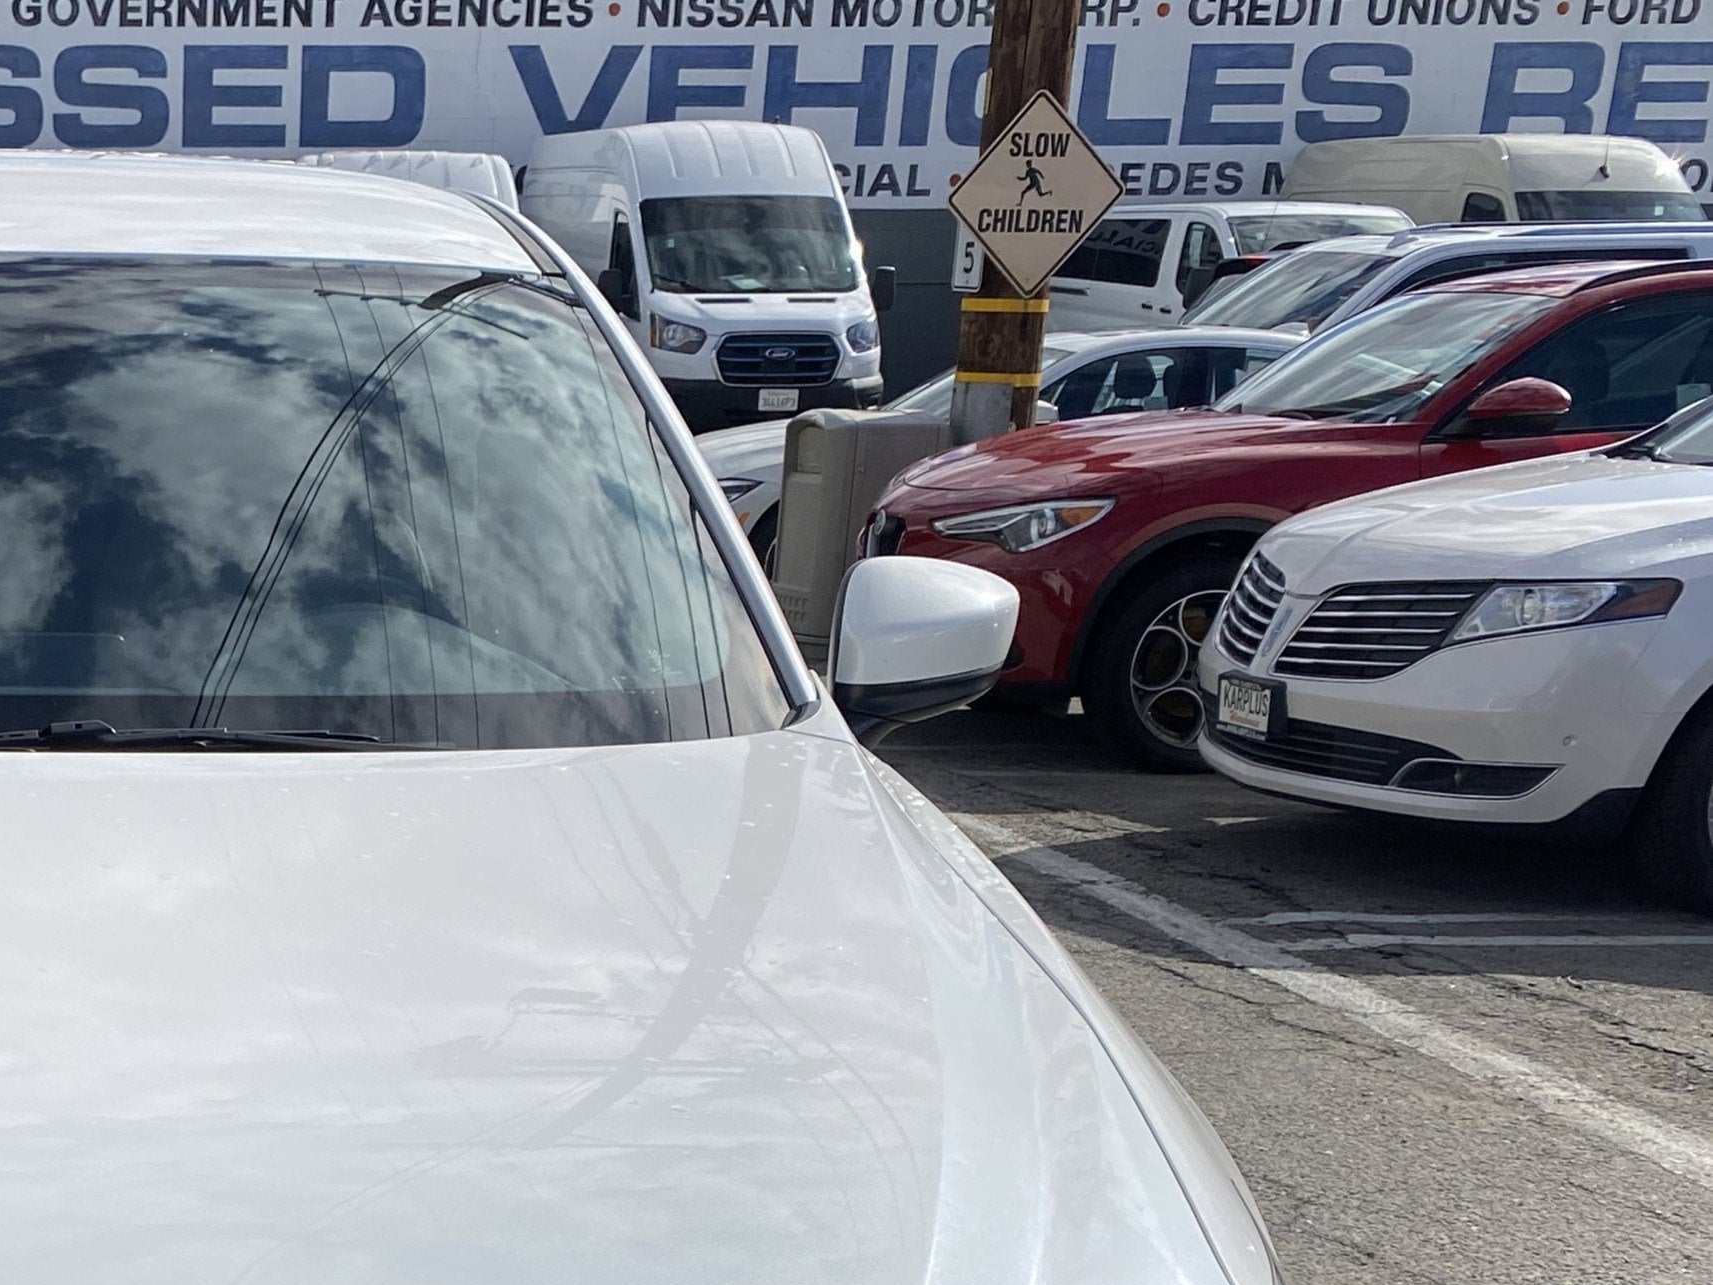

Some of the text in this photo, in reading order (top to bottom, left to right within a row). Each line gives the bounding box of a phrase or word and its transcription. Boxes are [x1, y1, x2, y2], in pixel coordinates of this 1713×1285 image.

[12, 0, 594, 27] GOVERNMENT AGENCIES
[637, 0, 1141, 28] NISSAN MOTOR RP.
[1187, 0, 1540, 26] CREDIT UNIONS
[1582, 0, 1698, 26] FORD
[1009, 132, 1071, 157] SLOW
[977, 208, 1084, 233] CHILDREN
[1223, 684, 1269, 717] KARPLUS
